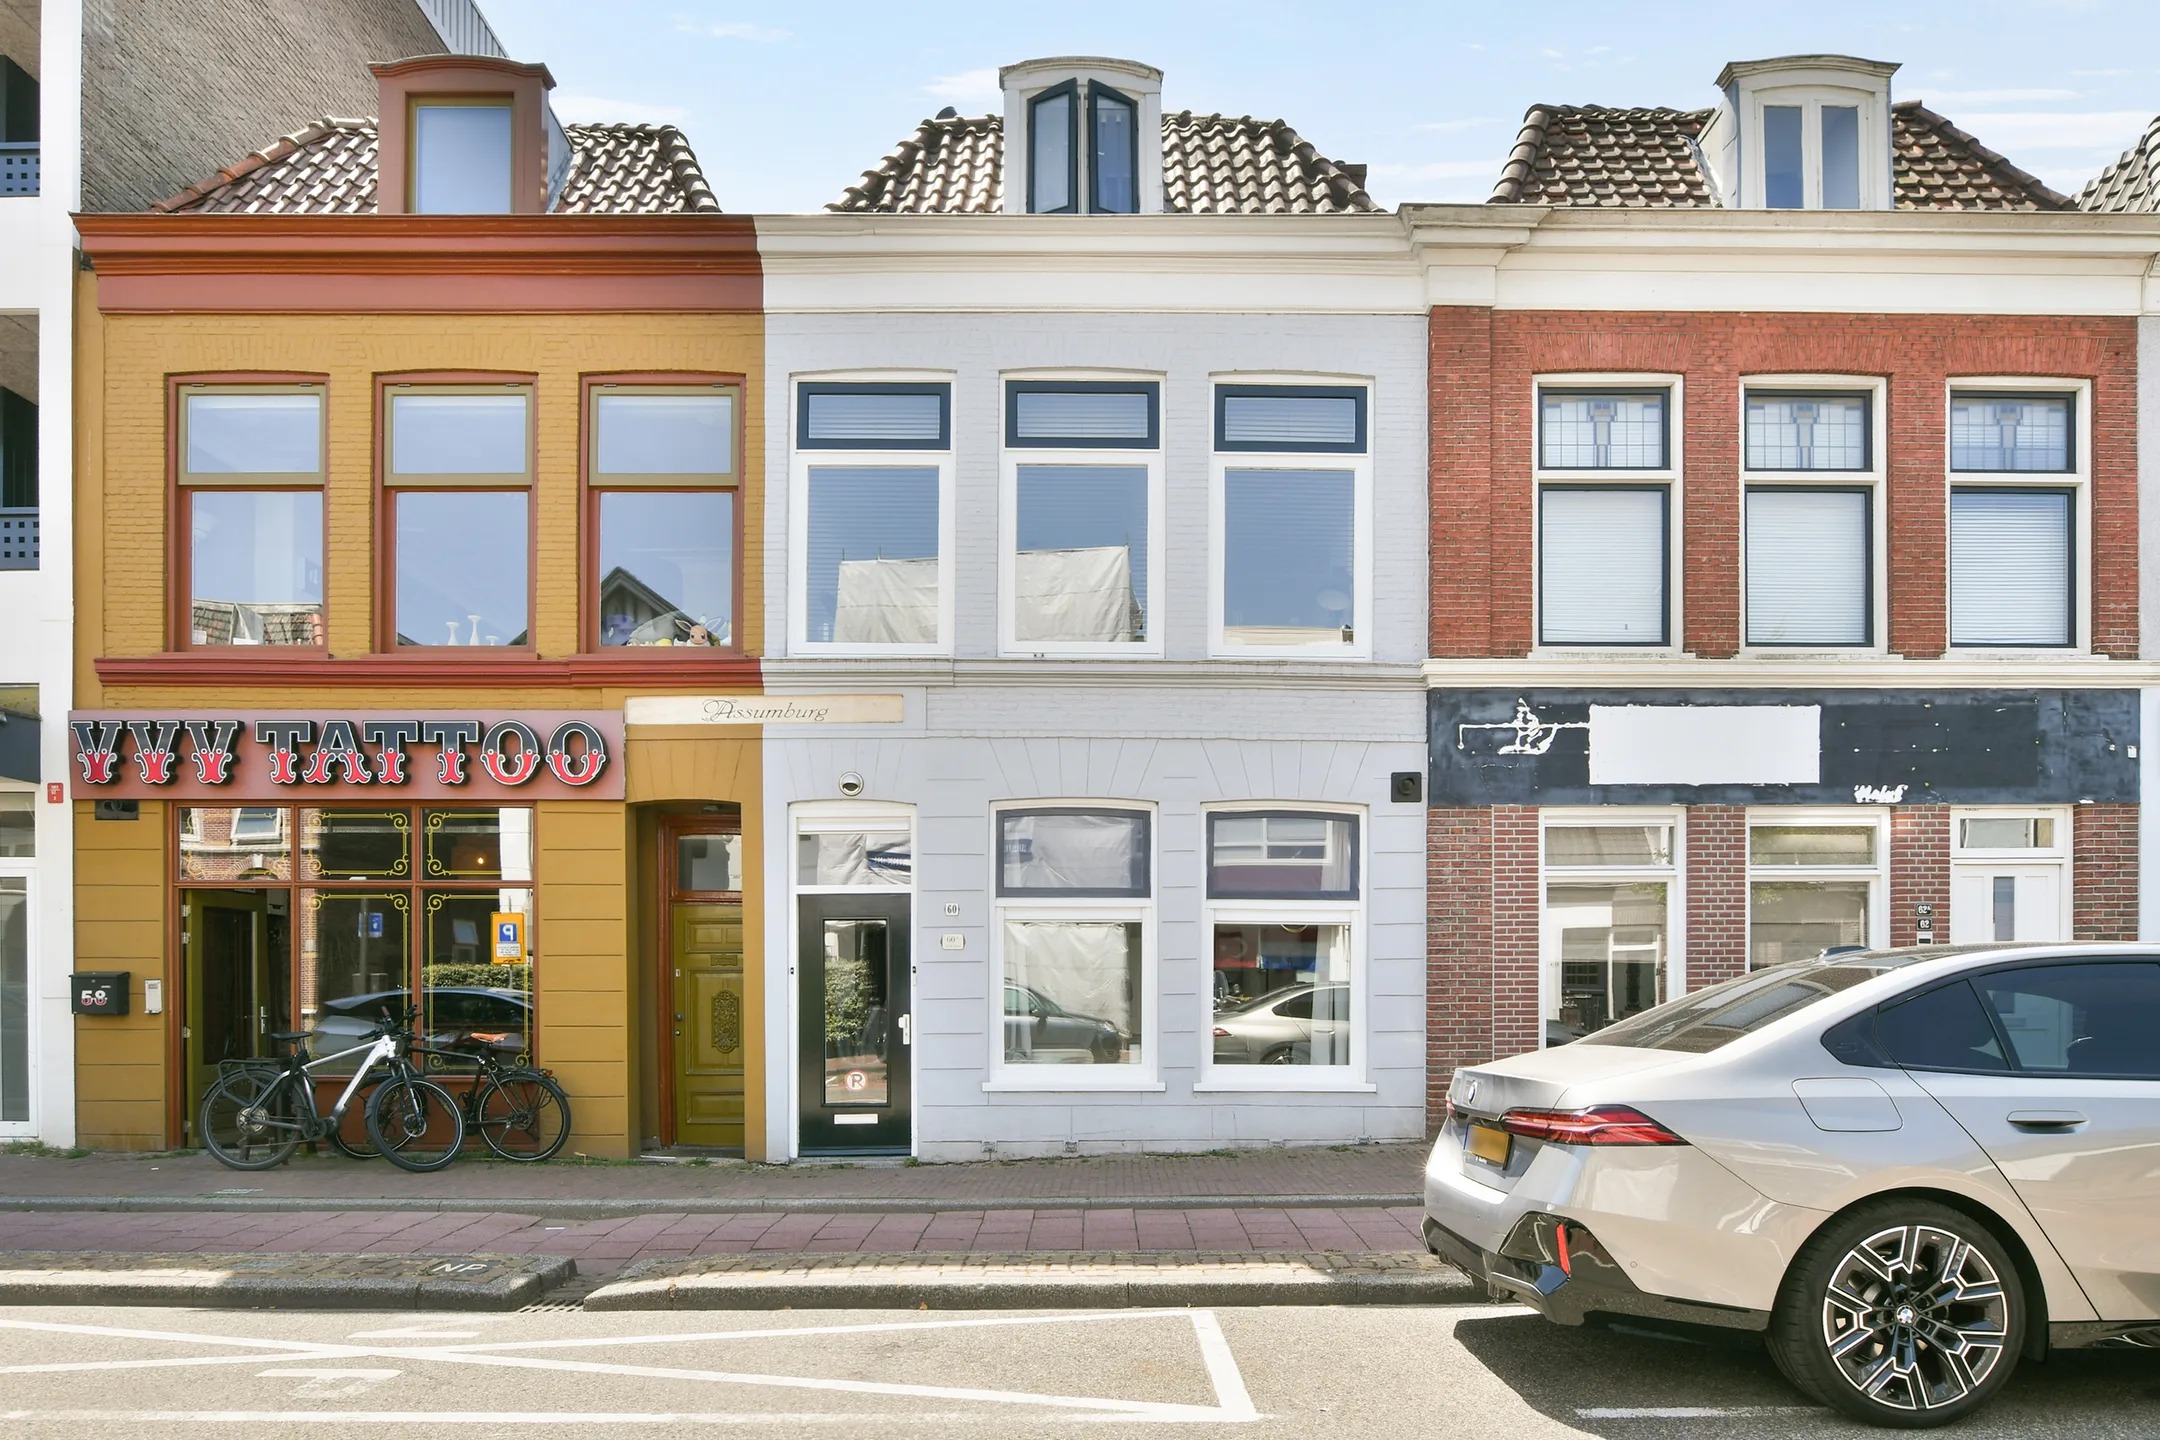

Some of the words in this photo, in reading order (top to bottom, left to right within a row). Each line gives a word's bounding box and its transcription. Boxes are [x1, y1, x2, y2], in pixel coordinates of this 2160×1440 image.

[701, 698, 829, 723] Assumburg
[69, 719, 246, 786] VVV
[254, 719, 611, 787] TATTOO
[947, 904, 957, 914] 60
[1920, 919, 1930, 929] 62
[81, 990, 107, 1006] 58
[432, 1263, 487, 1273] NP
